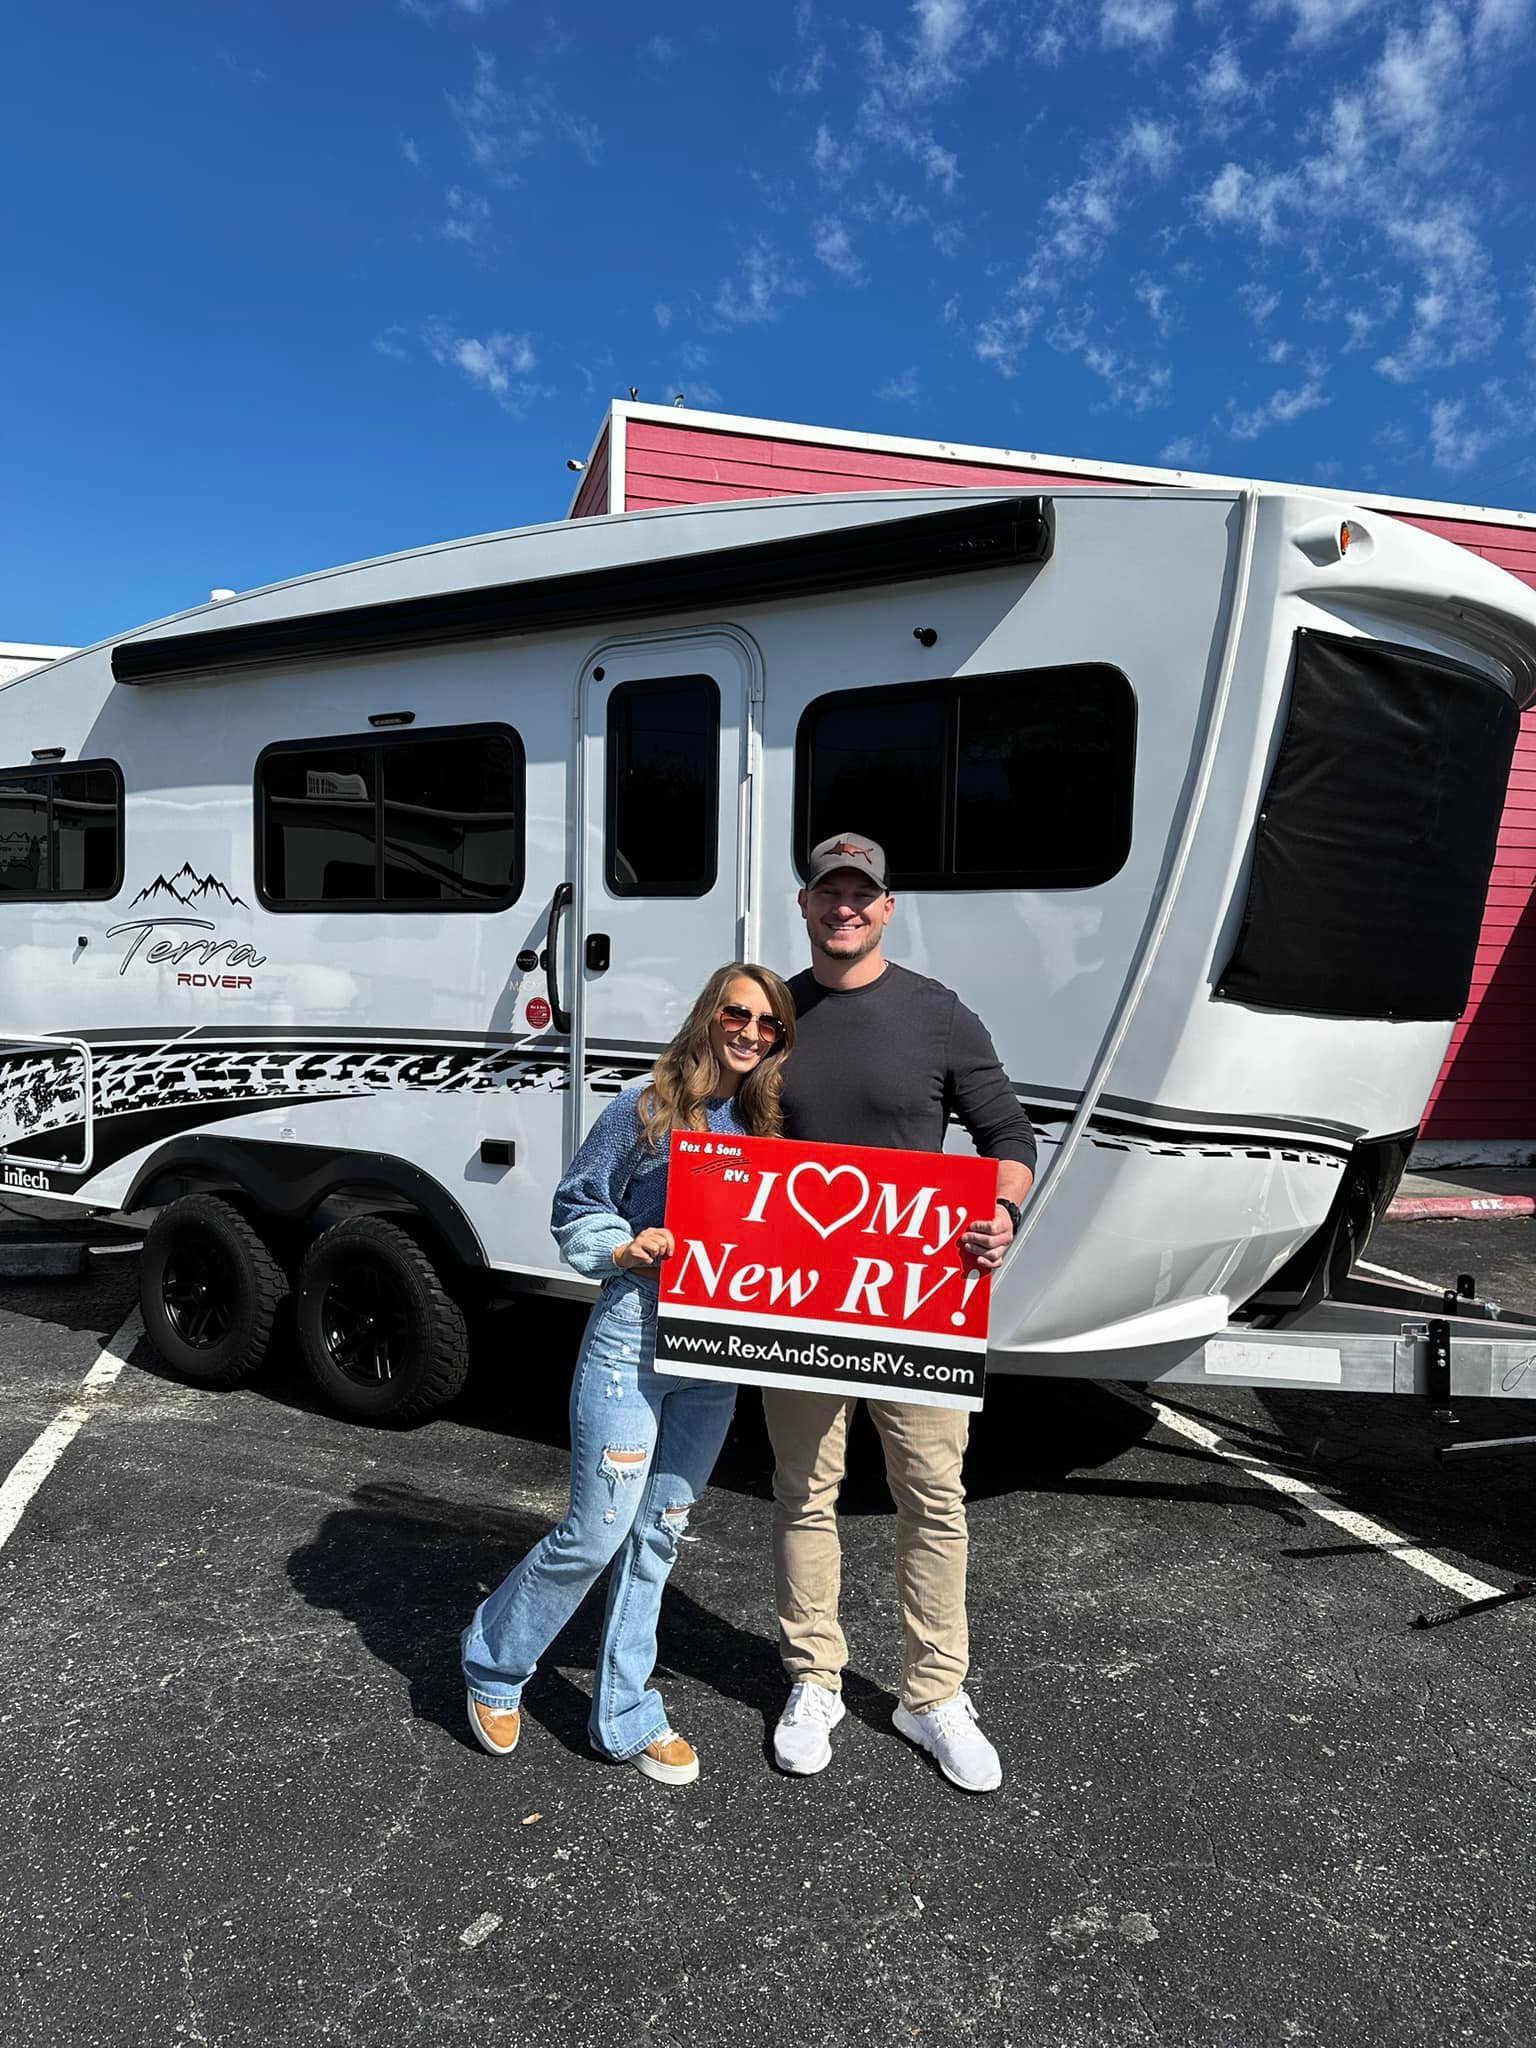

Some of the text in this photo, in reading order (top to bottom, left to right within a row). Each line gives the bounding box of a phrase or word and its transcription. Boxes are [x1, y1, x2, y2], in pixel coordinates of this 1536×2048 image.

[106, 917, 267, 976] Terra
[177, 973, 252, 989] ROVER
[679, 1140, 742, 1157] Rex & Sons
[4, 1165, 50, 1190] inTech
[723, 1168, 750, 1183] RVs
[742, 1171, 968, 1256] I My
[667, 1239, 981, 1327] New RV!
[664, 1333, 975, 1384] www.RexAndSonsRVs.com
